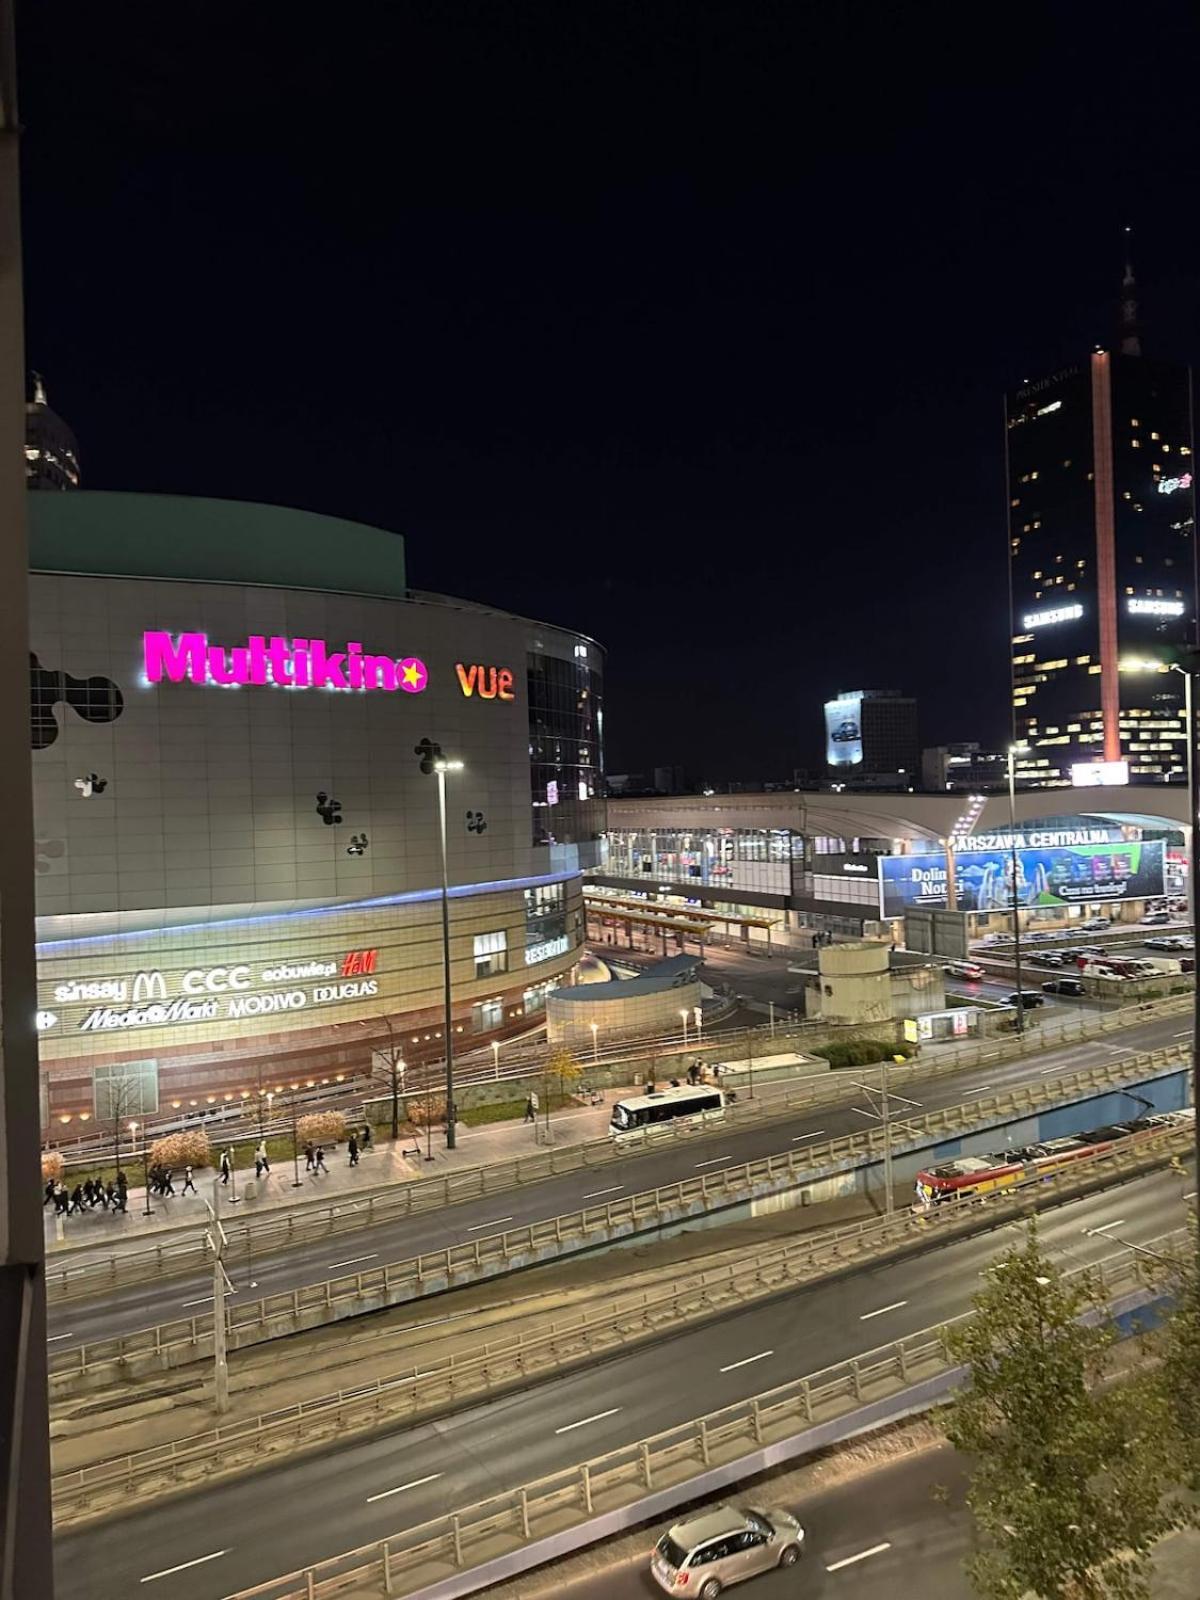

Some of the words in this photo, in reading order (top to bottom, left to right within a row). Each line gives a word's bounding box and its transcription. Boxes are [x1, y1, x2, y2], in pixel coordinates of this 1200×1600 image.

[142, 631, 428, 693] Multikino
[1029, 830, 1109, 848] CENTRALNA
[912, 867, 958, 882] Dolin
[262, 961, 337, 982] eobuwie.pl
[341, 950, 379, 976] H&M
[54, 980, 126, 1003] sinsay
[182, 966, 251, 994] CCC
[313, 980, 378, 1002] DOUGLAS
[227, 991, 306, 1018] MODIVO
